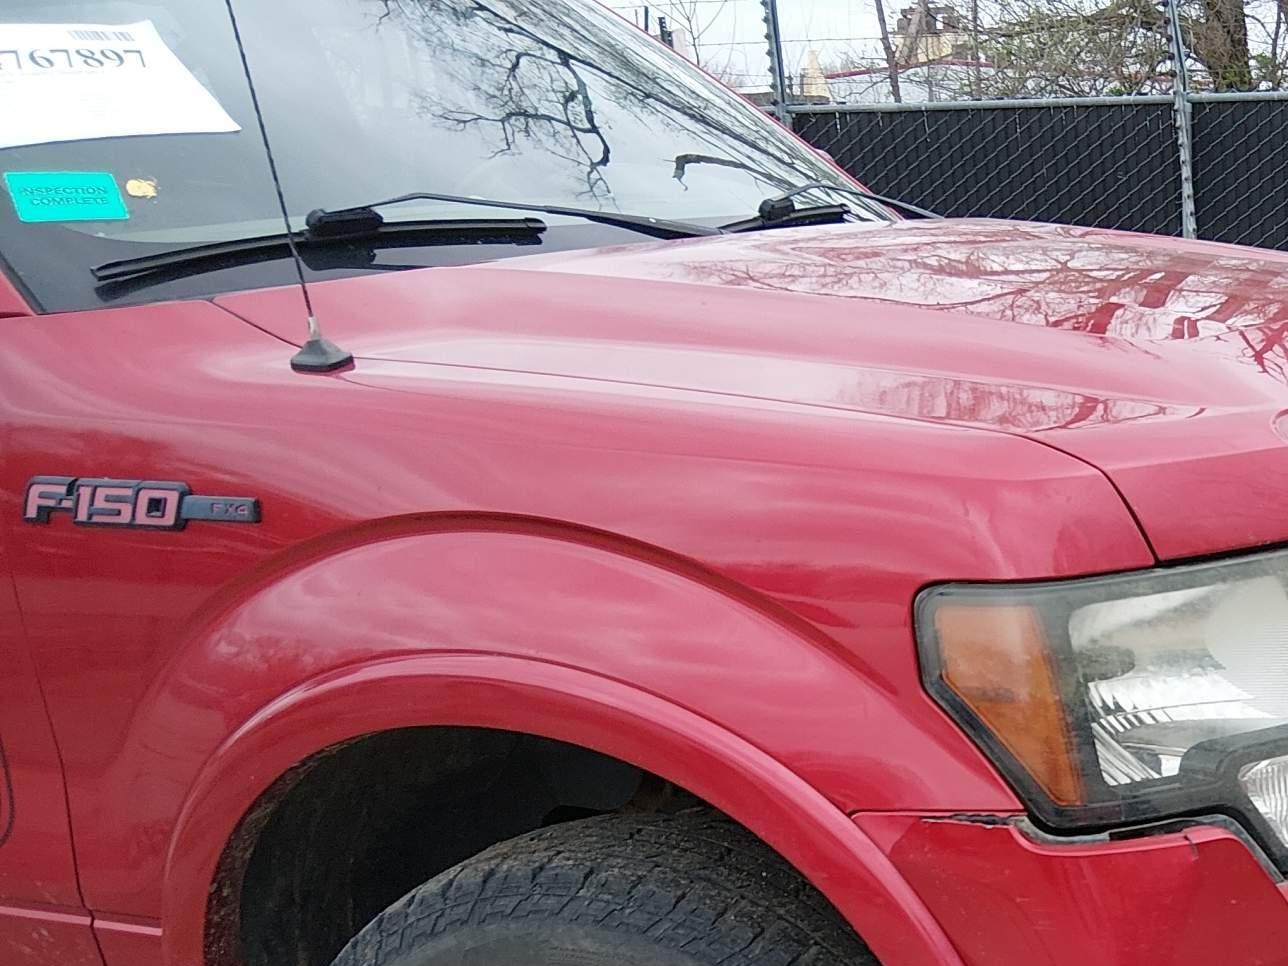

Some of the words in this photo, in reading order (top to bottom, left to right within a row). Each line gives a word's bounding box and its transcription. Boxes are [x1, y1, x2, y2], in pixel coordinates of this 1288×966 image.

[0, 48, 148, 70] 767897
[20, 185, 107, 196] INSPECTION
[30, 196, 109, 206] COMPLETE
[23, 479, 187, 528] F-150
[209, 502, 249, 515] FX4
